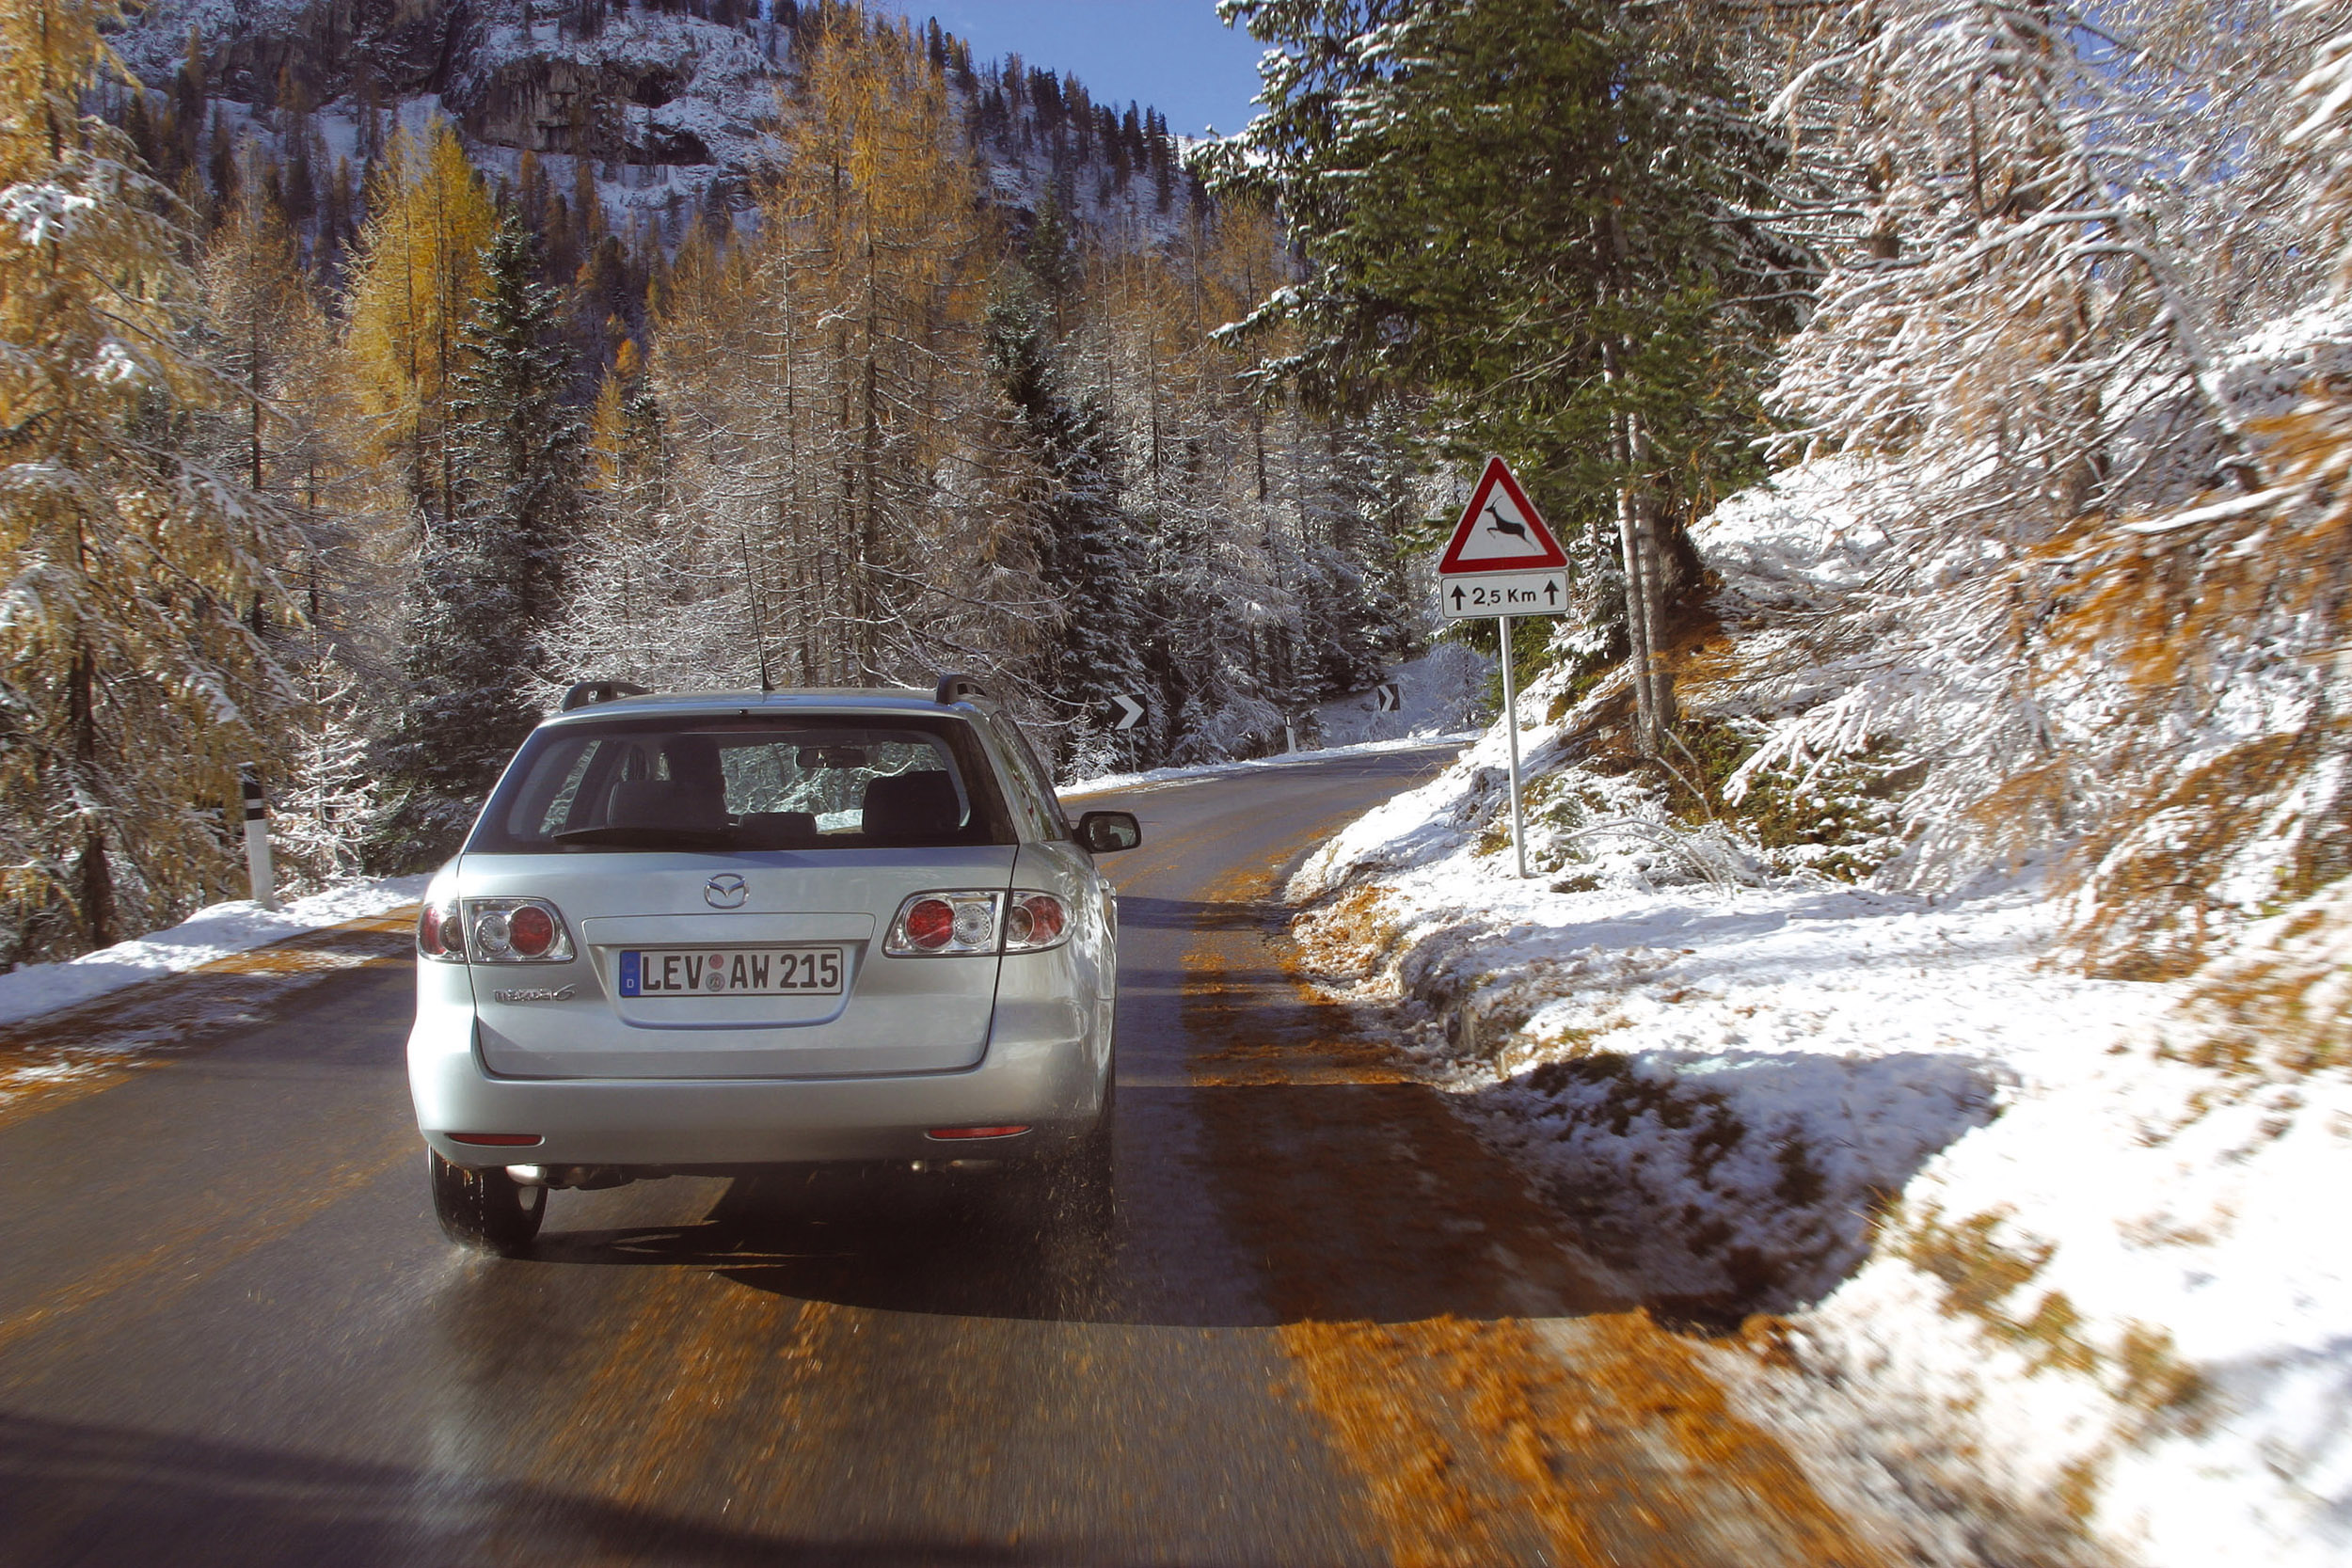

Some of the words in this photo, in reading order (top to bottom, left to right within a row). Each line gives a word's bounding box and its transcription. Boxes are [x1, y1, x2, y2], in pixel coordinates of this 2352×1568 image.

[1508, 589, 1536, 603] Km
[627, 978, 634, 989] D
[643, 955, 704, 990] LEV
[729, 954, 771, 989] AW
[779, 953, 838, 989] 215
